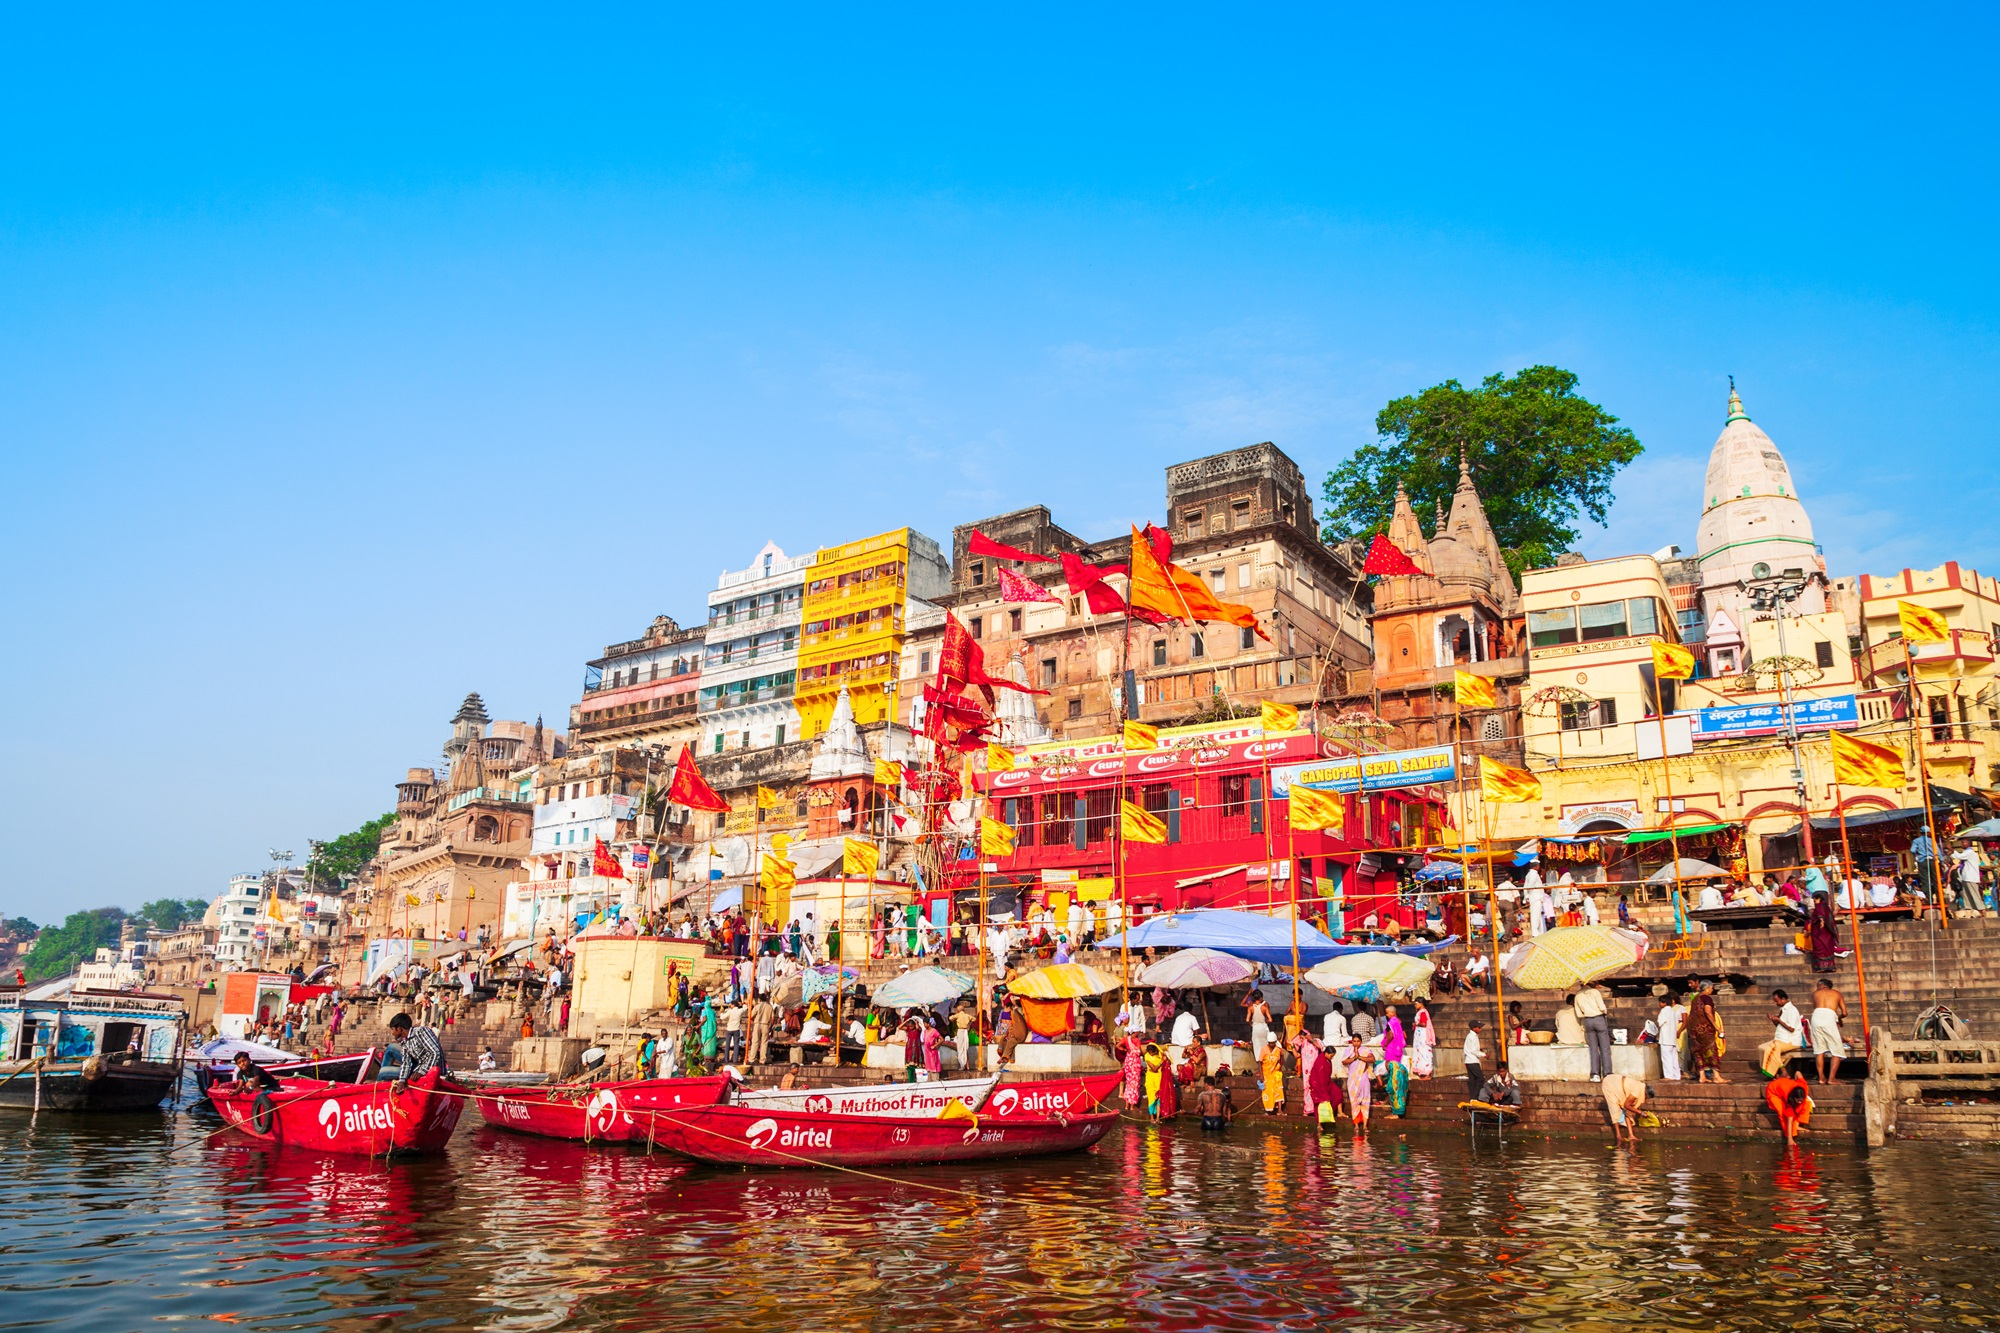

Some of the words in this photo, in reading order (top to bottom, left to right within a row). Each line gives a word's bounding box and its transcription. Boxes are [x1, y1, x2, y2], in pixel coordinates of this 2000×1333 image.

[1200, 749, 1229, 759] RUPA
[1254, 741, 1286, 753] RUPA
[1098, 760, 1126, 770] RUPA
[1148, 754, 1178, 764] RUPA
[1003, 770, 1030, 780] RUPA
[1300, 764, 1362, 784] GANGOTRI
[1365, 760, 1399, 777] SEVA
[1401, 753, 1449, 772] SAMITI
[840, 1096, 906, 1113] Muthoot
[1022, 1091, 1070, 1110] airtel
[344, 1103, 395, 1132] airtel
[780, 1125, 833, 1148] airtel
[891, 1127, 910, 1145] (13)
[981, 1129, 1004, 1142] airtel
